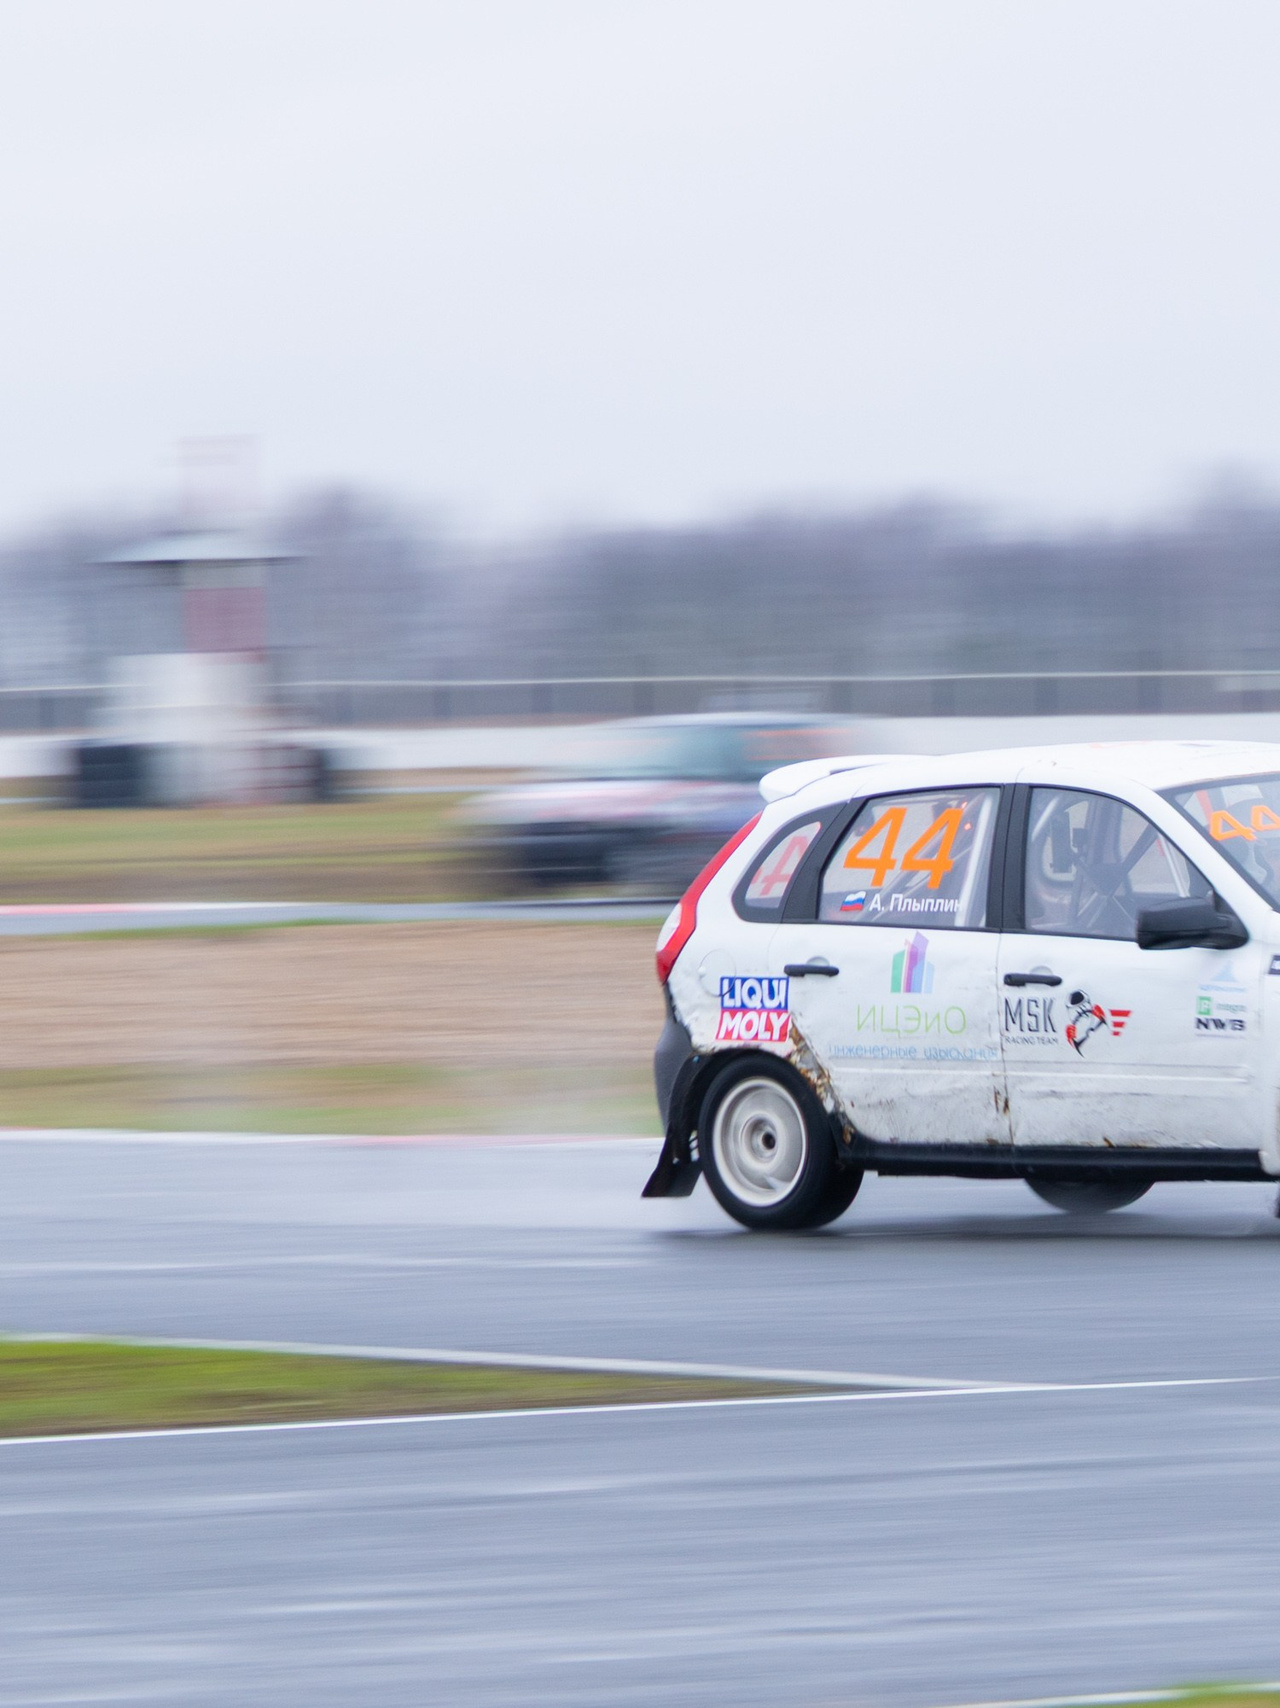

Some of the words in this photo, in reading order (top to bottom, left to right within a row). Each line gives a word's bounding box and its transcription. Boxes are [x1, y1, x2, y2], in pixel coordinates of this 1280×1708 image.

[843, 806, 964, 890] 44
[721, 978, 787, 1009] LIQUI
[718, 1010, 789, 1041] MOLY
[1004, 998, 1057, 1033] MSK
[1195, 1017, 1246, 1031] NWB
